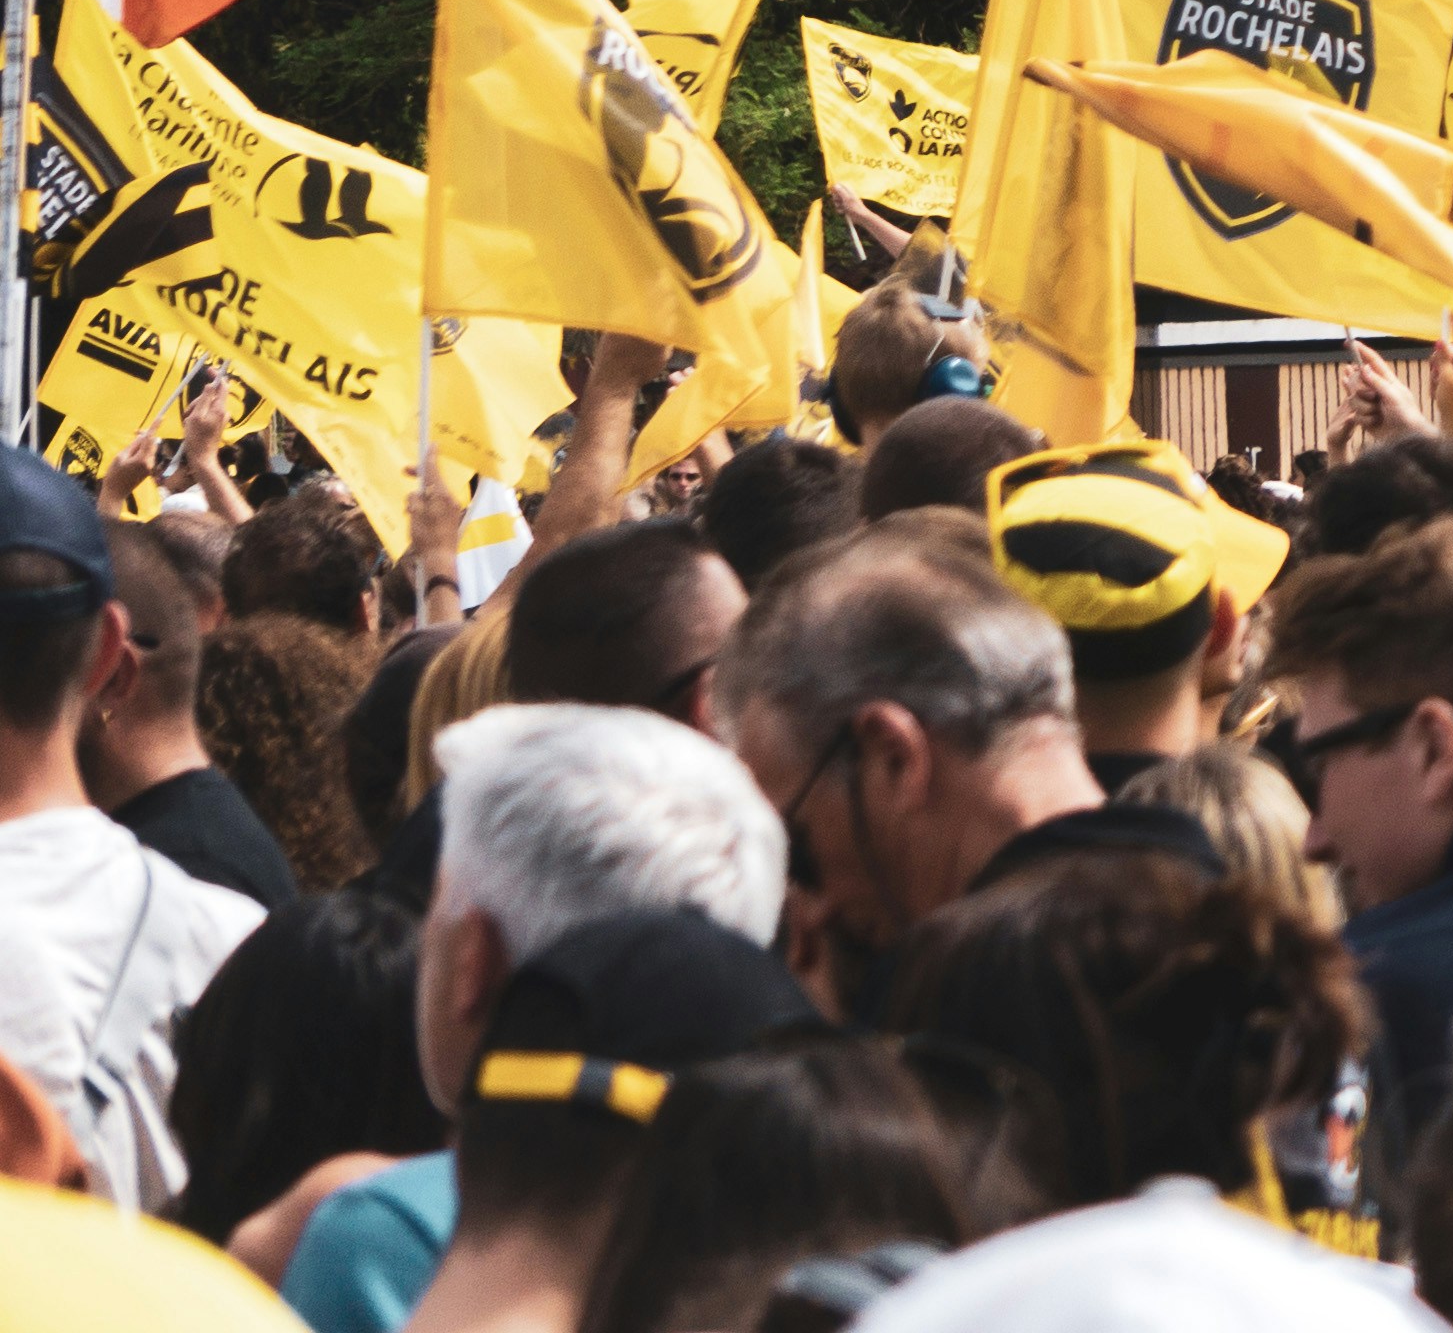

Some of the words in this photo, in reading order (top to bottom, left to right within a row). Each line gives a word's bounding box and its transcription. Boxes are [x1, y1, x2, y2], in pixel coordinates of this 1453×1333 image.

[1177, 0, 1366, 74] ROCHELAIS
[918, 142, 939, 156] LA
[87, 307, 163, 358] AVIA
